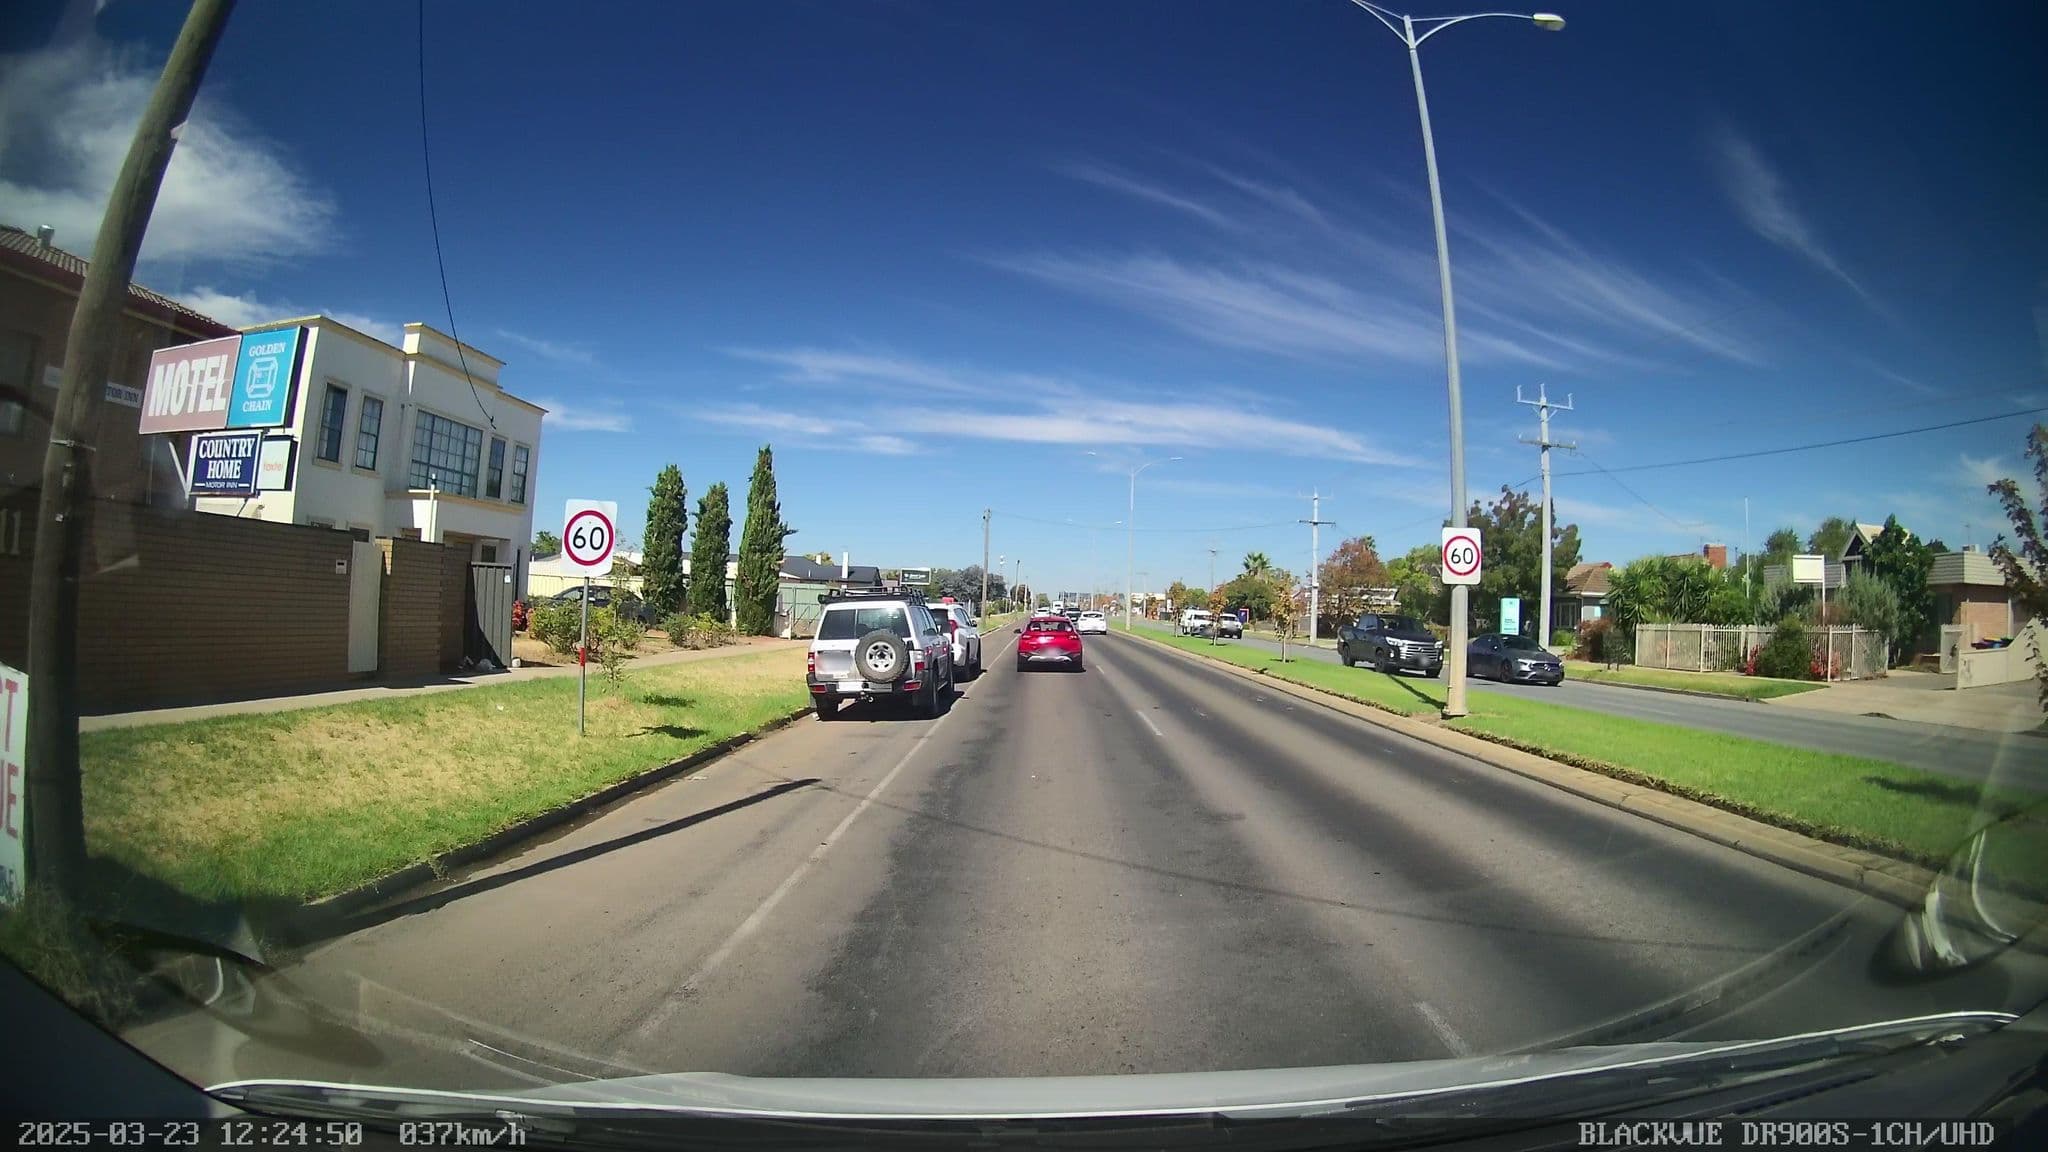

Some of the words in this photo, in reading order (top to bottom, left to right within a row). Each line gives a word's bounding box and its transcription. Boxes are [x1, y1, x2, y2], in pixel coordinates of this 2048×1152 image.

[249, 342, 286, 357] GOLDEN
[148, 355, 228, 417] MOTEL
[242, 400, 273, 413] CHAIN
[199, 438, 256, 459] COUNTRY
[207, 460, 242, 479] HOME
[205, 481, 225, 489] MOTOR
[226, 481, 239, 489] INN
[573, 526, 605, 551] 60
[1451, 547, 1474, 565] 60
